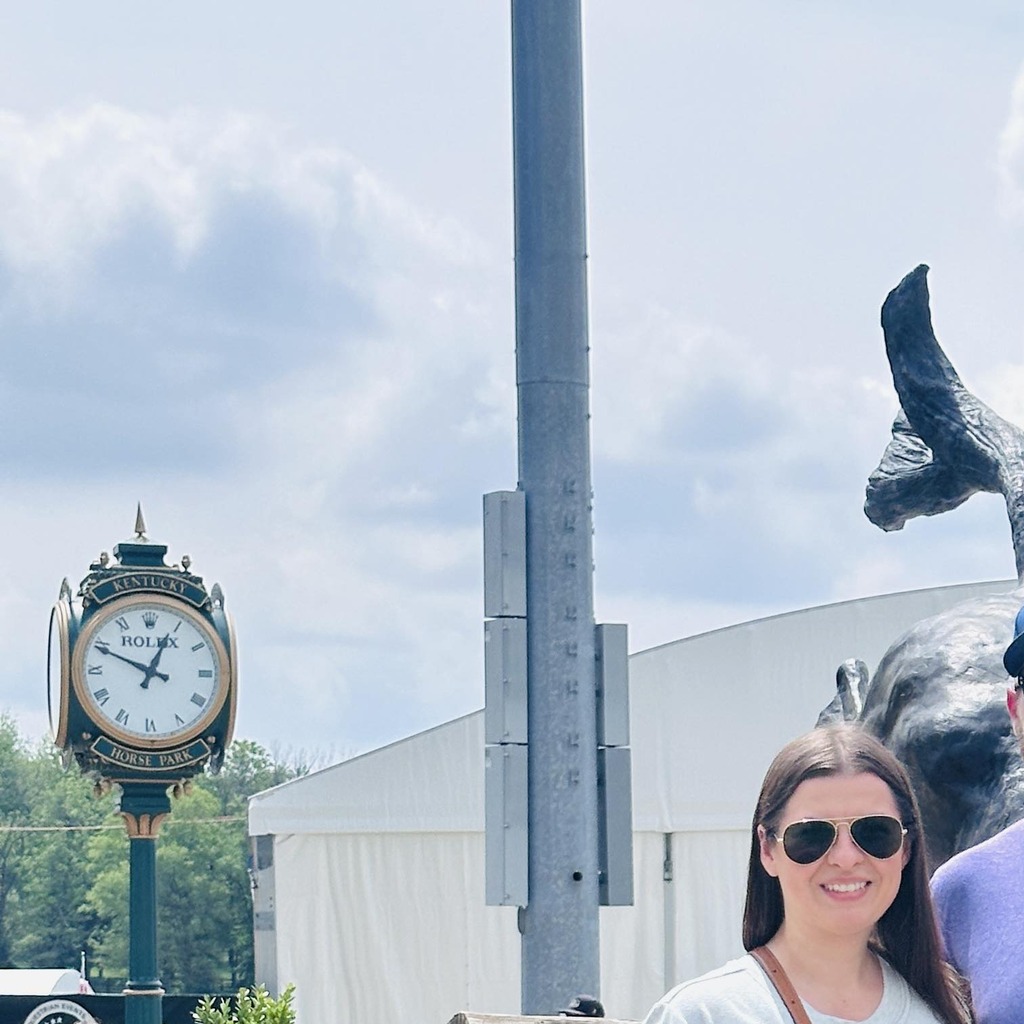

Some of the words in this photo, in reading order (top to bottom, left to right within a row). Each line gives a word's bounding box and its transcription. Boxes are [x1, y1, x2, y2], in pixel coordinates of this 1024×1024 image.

[112, 576, 188, 594] KENTUCKY
[110, 747, 152, 766] HORSE
[159, 748, 193, 766] PARK
